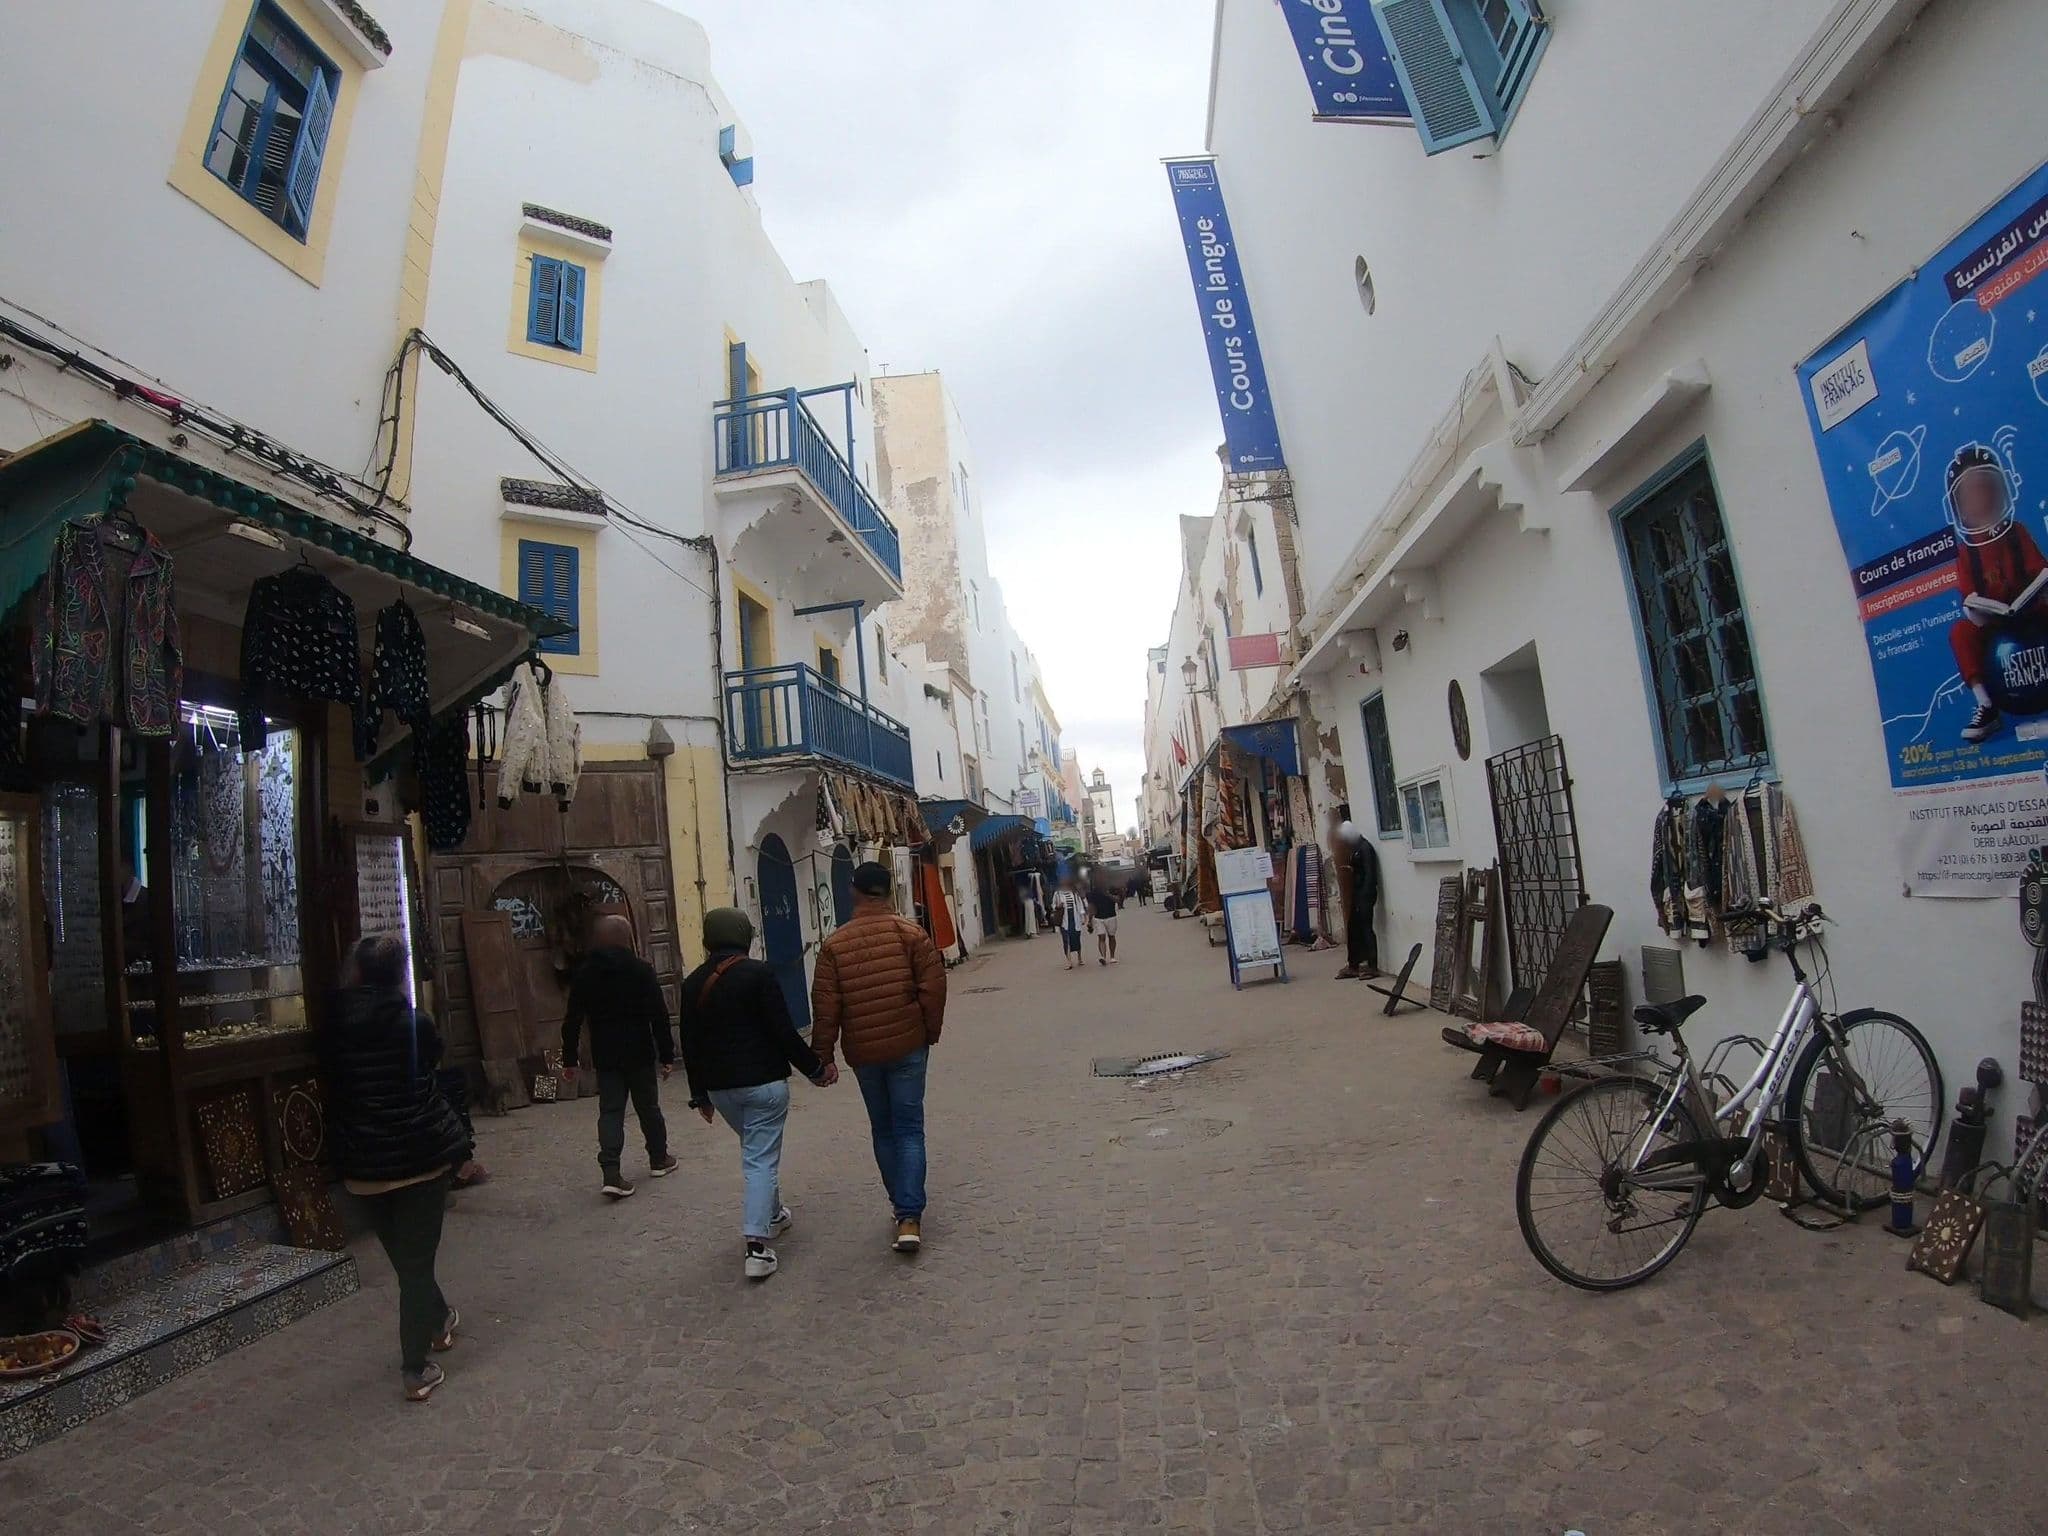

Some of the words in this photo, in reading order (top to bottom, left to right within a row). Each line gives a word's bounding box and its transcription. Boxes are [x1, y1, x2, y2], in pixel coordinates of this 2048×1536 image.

[1197, 216, 1228, 291] langue
[1954, 228, 2023, 289] الفرنسية
[1212, 299, 1236, 329] de
[1224, 337, 1254, 410] Cours
[1820, 360, 1858, 395] INSTITUT
[1823, 369, 1865, 410] FRANÇAIS
[1859, 565, 1889, 584] Cours
[1890, 556, 1905, 571] de
[1906, 534, 1954, 565] français
[1866, 587, 1915, 614] Inscriptions
[1916, 570, 1958, 593] ouvertes
[1902, 622, 1921, 635] vers
[1877, 651, 1887, 660] du
[1887, 638, 1919, 655] français
[2001, 646, 2047, 672] INSTITUT
[1909, 807, 1950, 821] INSTITUT
[1953, 802, 2006, 817] FRANÇAIS
[1970, 819, 2006, 834] الصويرة
[1974, 837, 1996, 848] DERB
[2001, 852, 2013, 863] 80
